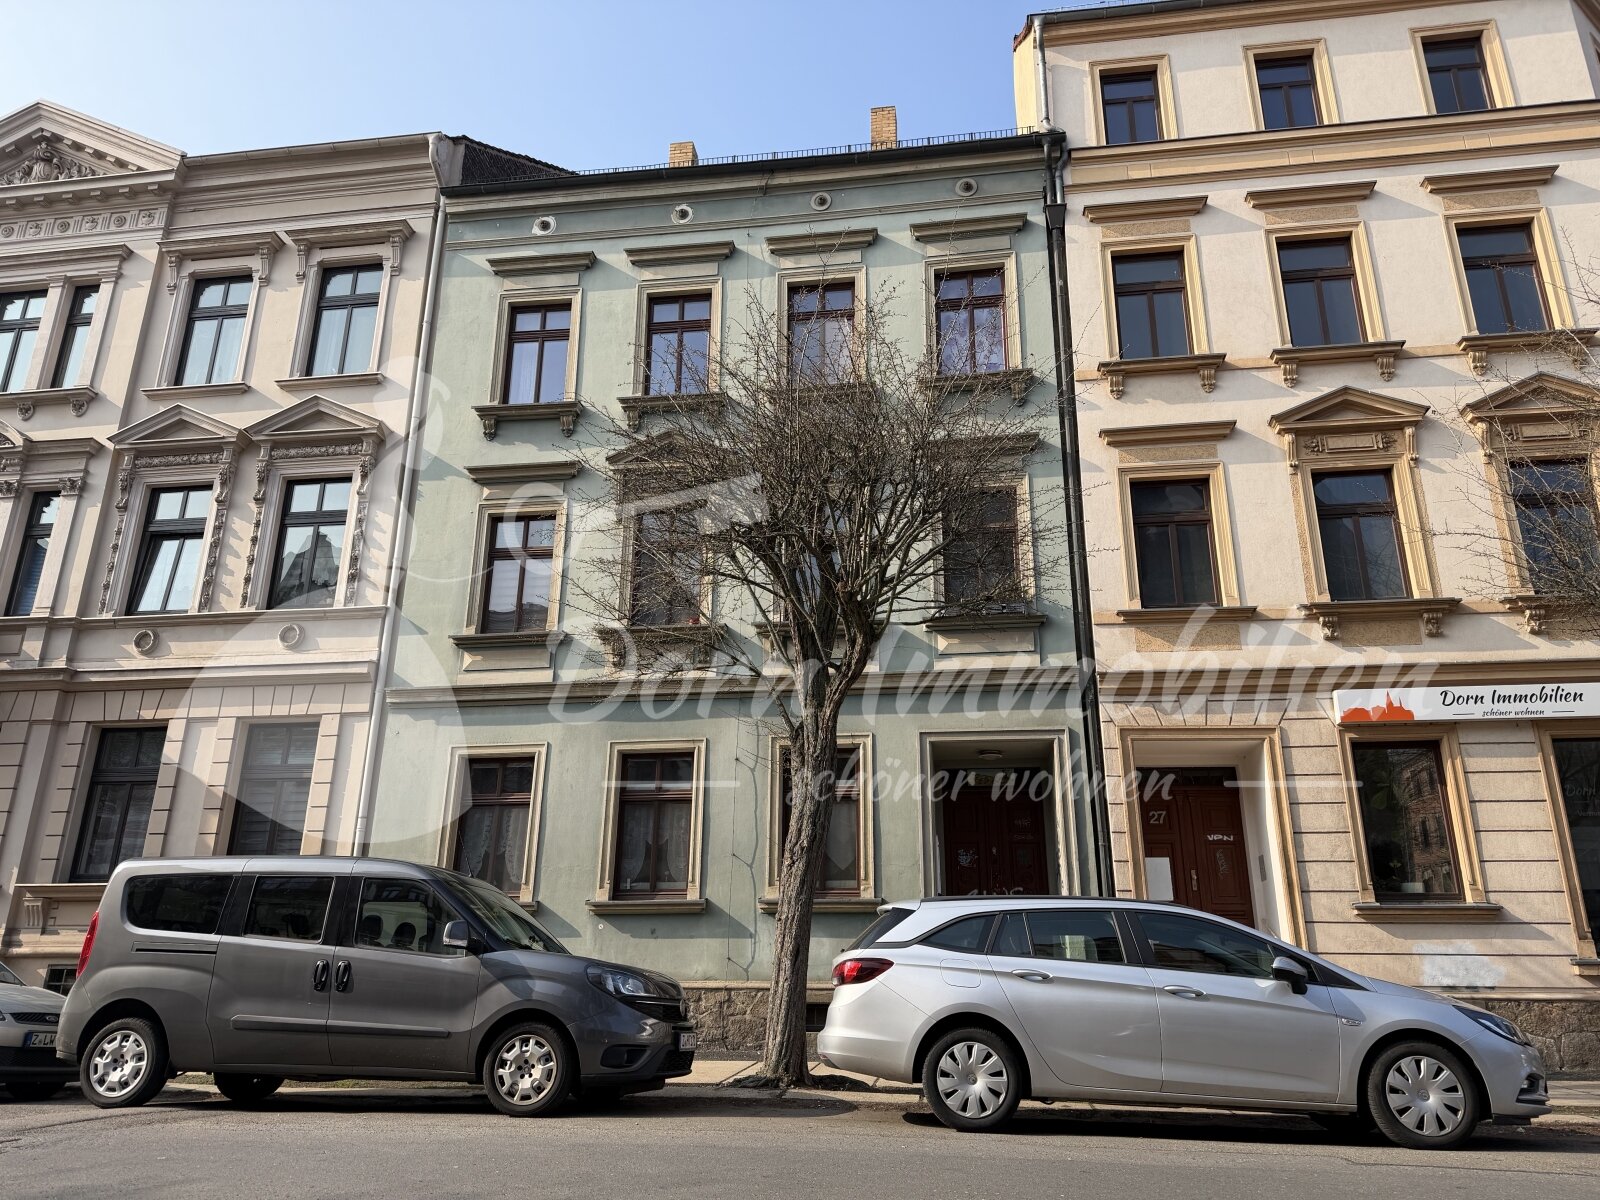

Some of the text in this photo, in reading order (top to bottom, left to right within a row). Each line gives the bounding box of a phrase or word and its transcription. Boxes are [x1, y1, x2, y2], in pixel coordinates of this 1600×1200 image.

[1440, 685, 1584, 707] Dorn Immobilien
[1482, 707, 1545, 717] schöner wohnen
[1149, 811, 1166, 824] 27
